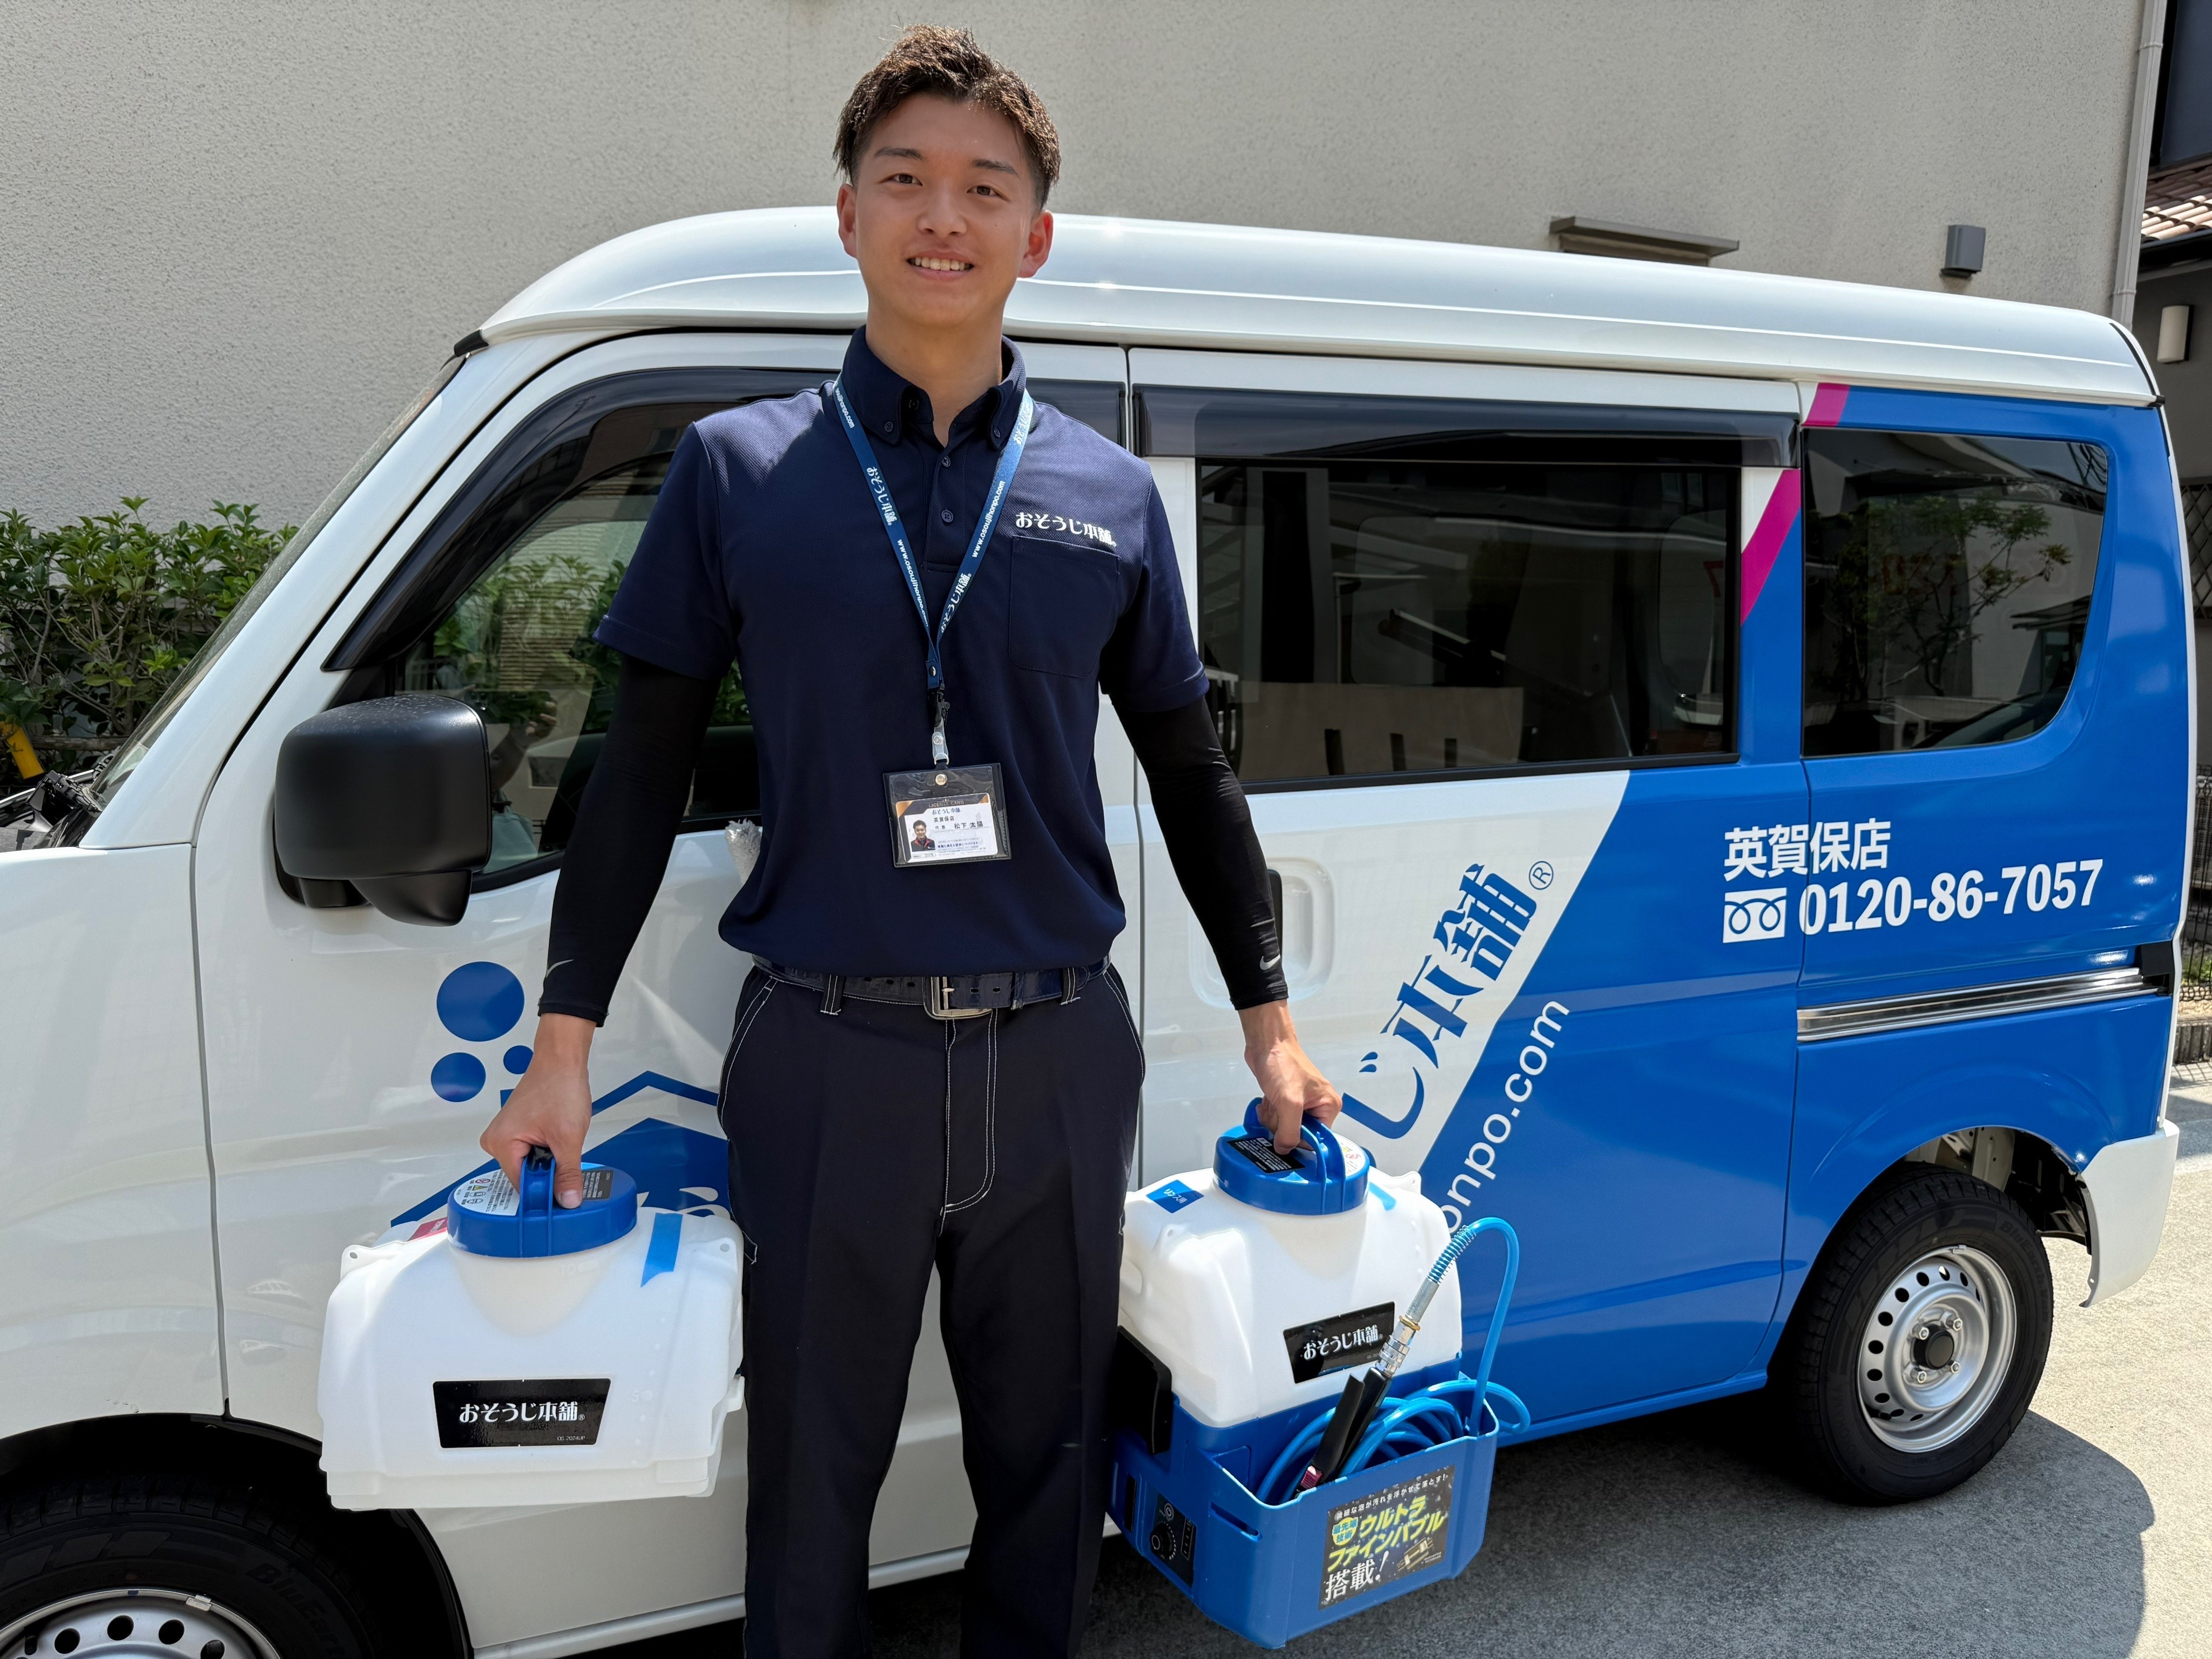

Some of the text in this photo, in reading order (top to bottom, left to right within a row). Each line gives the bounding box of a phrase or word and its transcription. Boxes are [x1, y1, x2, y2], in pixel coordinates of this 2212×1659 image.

[972, 480, 1006, 558] www.osoujihonpo.com
[1723, 818, 1891, 881] 英賀保店
[1798, 859, 2103, 936] 0120-86-7057
[1163, 1188, 1188, 1204] リンス用
[1327, 1510, 1446, 1573] ファインバブル
[1359, 1495, 1427, 1539] ウルトラ
